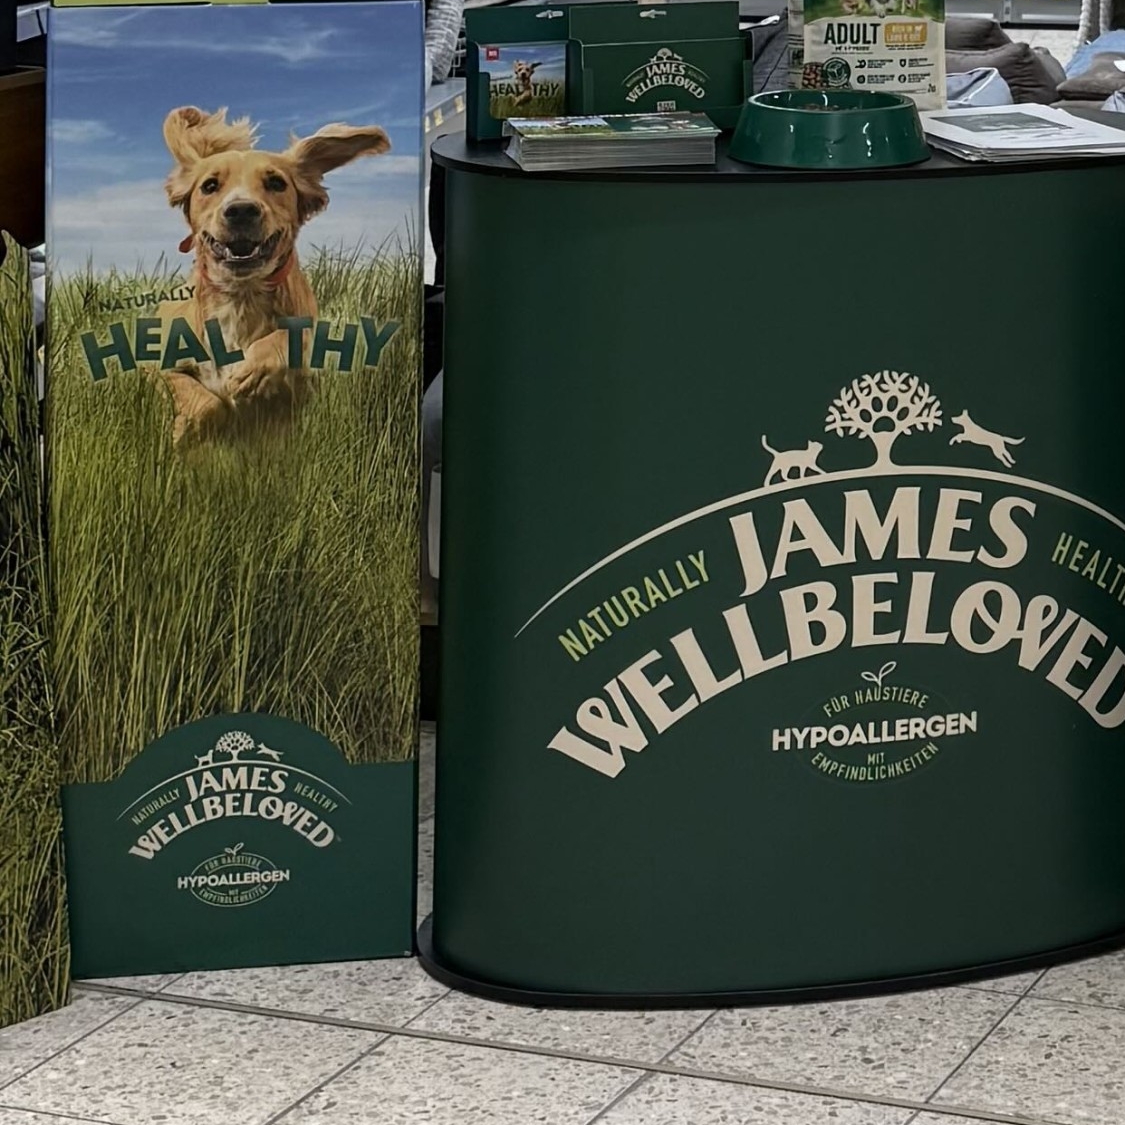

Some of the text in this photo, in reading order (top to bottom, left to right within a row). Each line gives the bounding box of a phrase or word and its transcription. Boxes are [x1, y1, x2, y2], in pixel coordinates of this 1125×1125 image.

[824, 23, 881, 44] ADULT
[646, 62, 686, 78] JAMES
[625, 74, 705, 103] WELLBELOVED
[100, 286, 196, 312] NATURALLY
[728, 486, 1037, 597] JAMES
[557, 549, 710, 662] NATURALLY
[822, 685, 930, 718] FÜR HAUSTIERE
[771, 711, 978, 752] HYPOALLERGEN
[810, 741, 939, 782] EMPFINDLICHKEITEN
[867, 752, 885, 765] MIT
[185, 766, 288, 802] JAMES
[294, 782, 338, 813] HEALTHY
[131, 788, 181, 825] NATURALLY
[177, 870, 290, 889] HYPOALLERGEN
